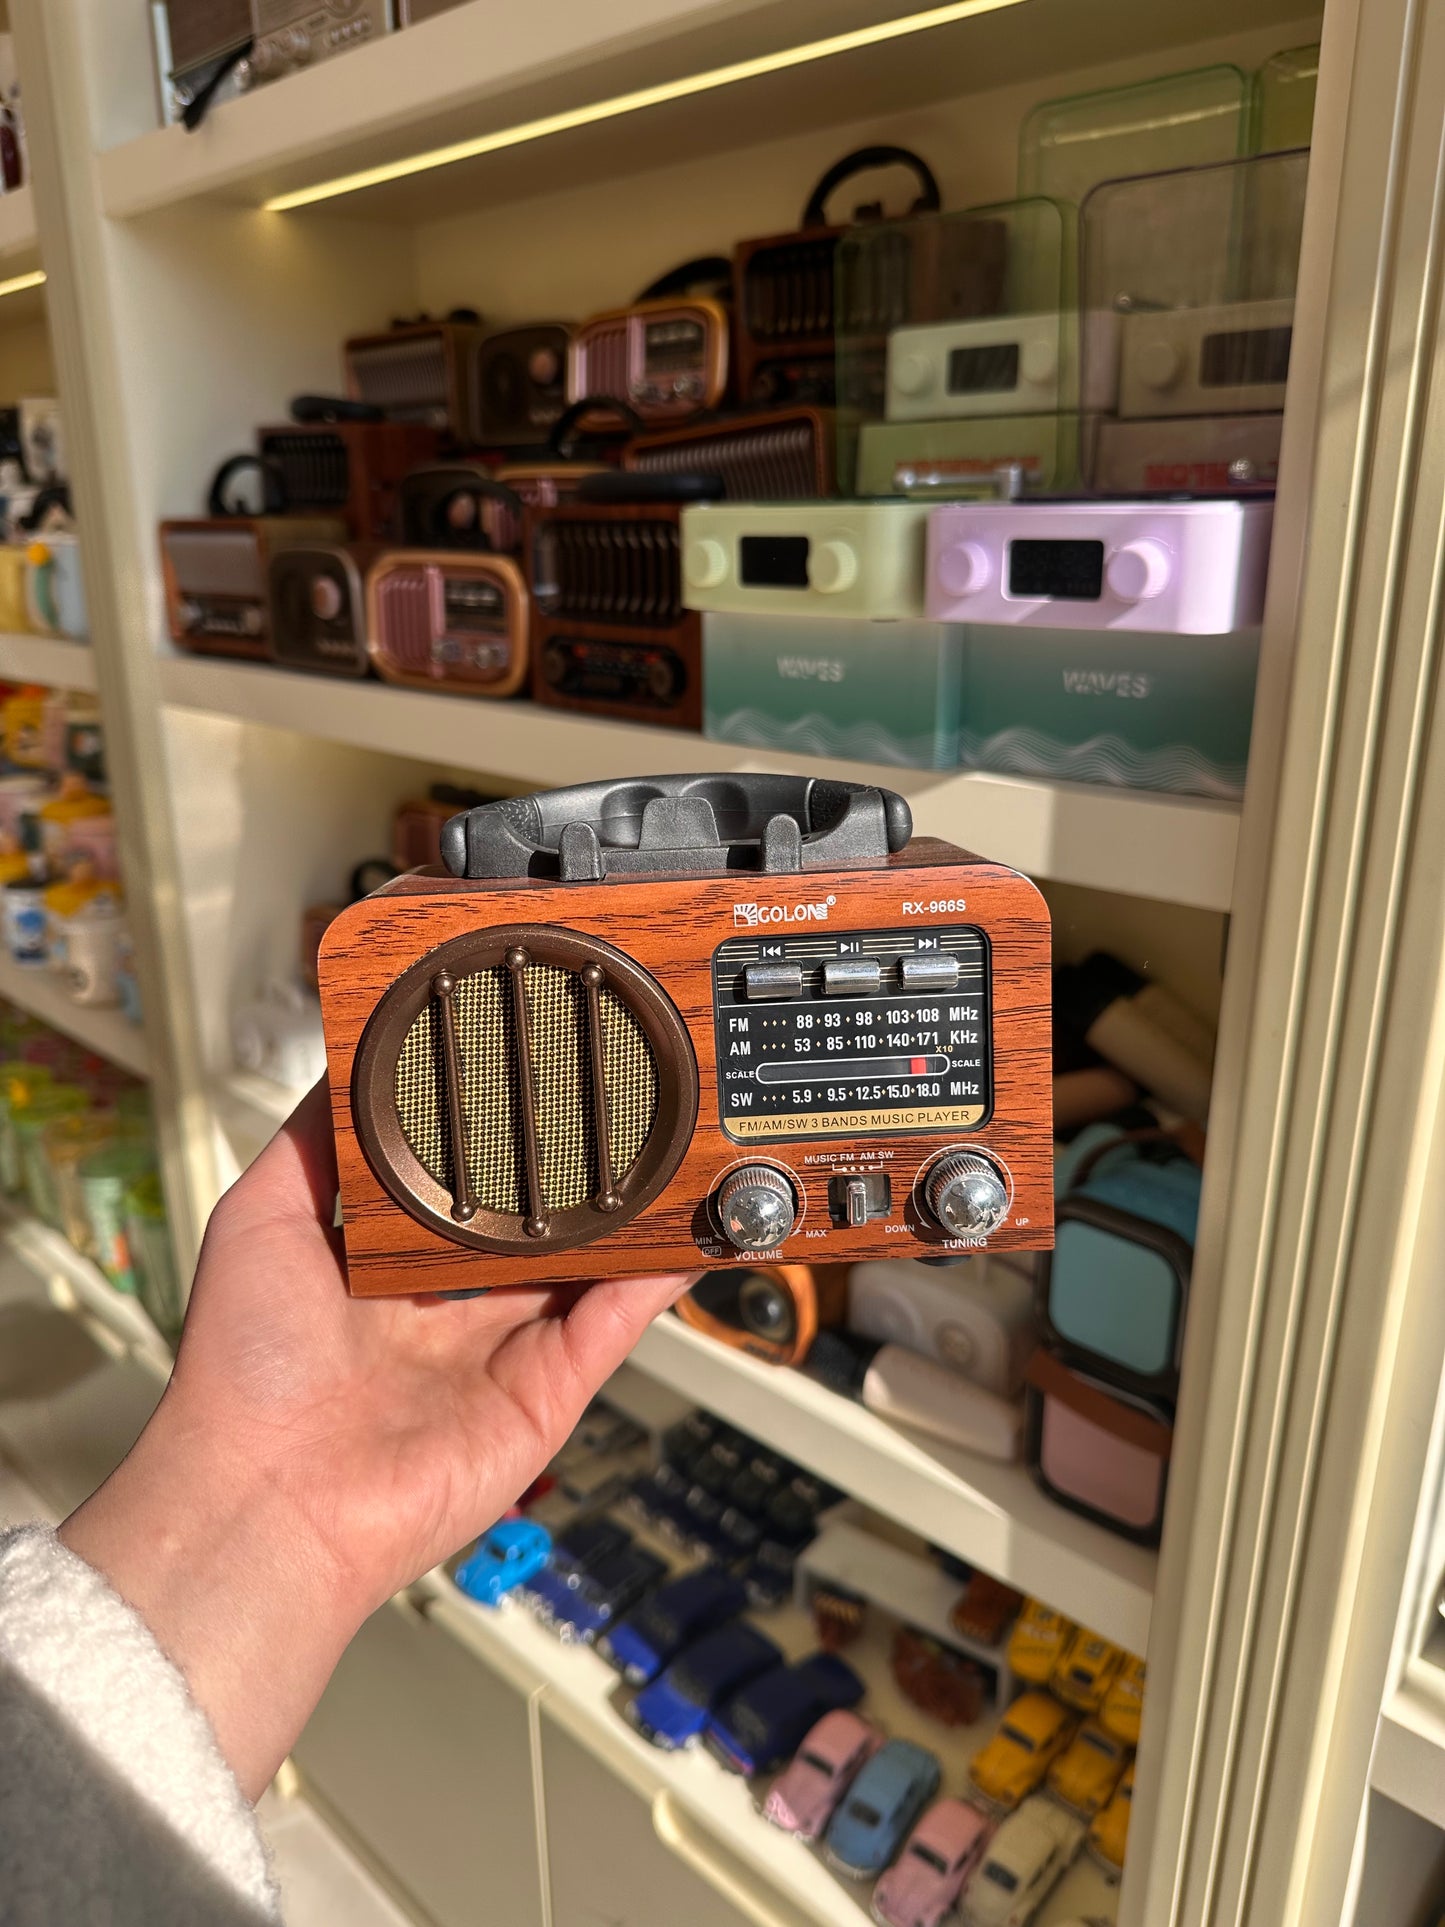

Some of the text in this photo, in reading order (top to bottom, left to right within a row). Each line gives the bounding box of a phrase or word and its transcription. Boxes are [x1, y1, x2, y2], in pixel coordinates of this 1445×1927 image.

[776, 656, 845, 682] WAVES
[1063, 668, 1150, 699] WAVES
[902, 899, 967, 915] RX-966S
[729, 1005, 979, 1032] FM 88 93 98 103 108 MHz
[729, 1029, 978, 1056] AM 53 85 110 140 171 KHz
[935, 1044, 954, 1054] X10
[951, 1059, 981, 1068] SCALE
[725, 1070, 755, 1080] SCALE
[731, 1081, 980, 1107] SW 5.9 9.5 12.5 15.0 18.0 MHz
[739, 1109, 970, 1132] FM/AM/SW 3 BANDS MUSIC PLAYER
[804, 1150, 894, 1164] MUSIC FM AM SW
[1015, 1217, 1030, 1226] UP
[805, 1229, 827, 1238] MAX
[884, 1224, 915, 1233] DOWN
[695, 1236, 713, 1245] MIN
[941, 1237, 988, 1249] TUNING
[704, 1247, 719, 1256] OFF
[734, 1249, 784, 1262] VOLUME
